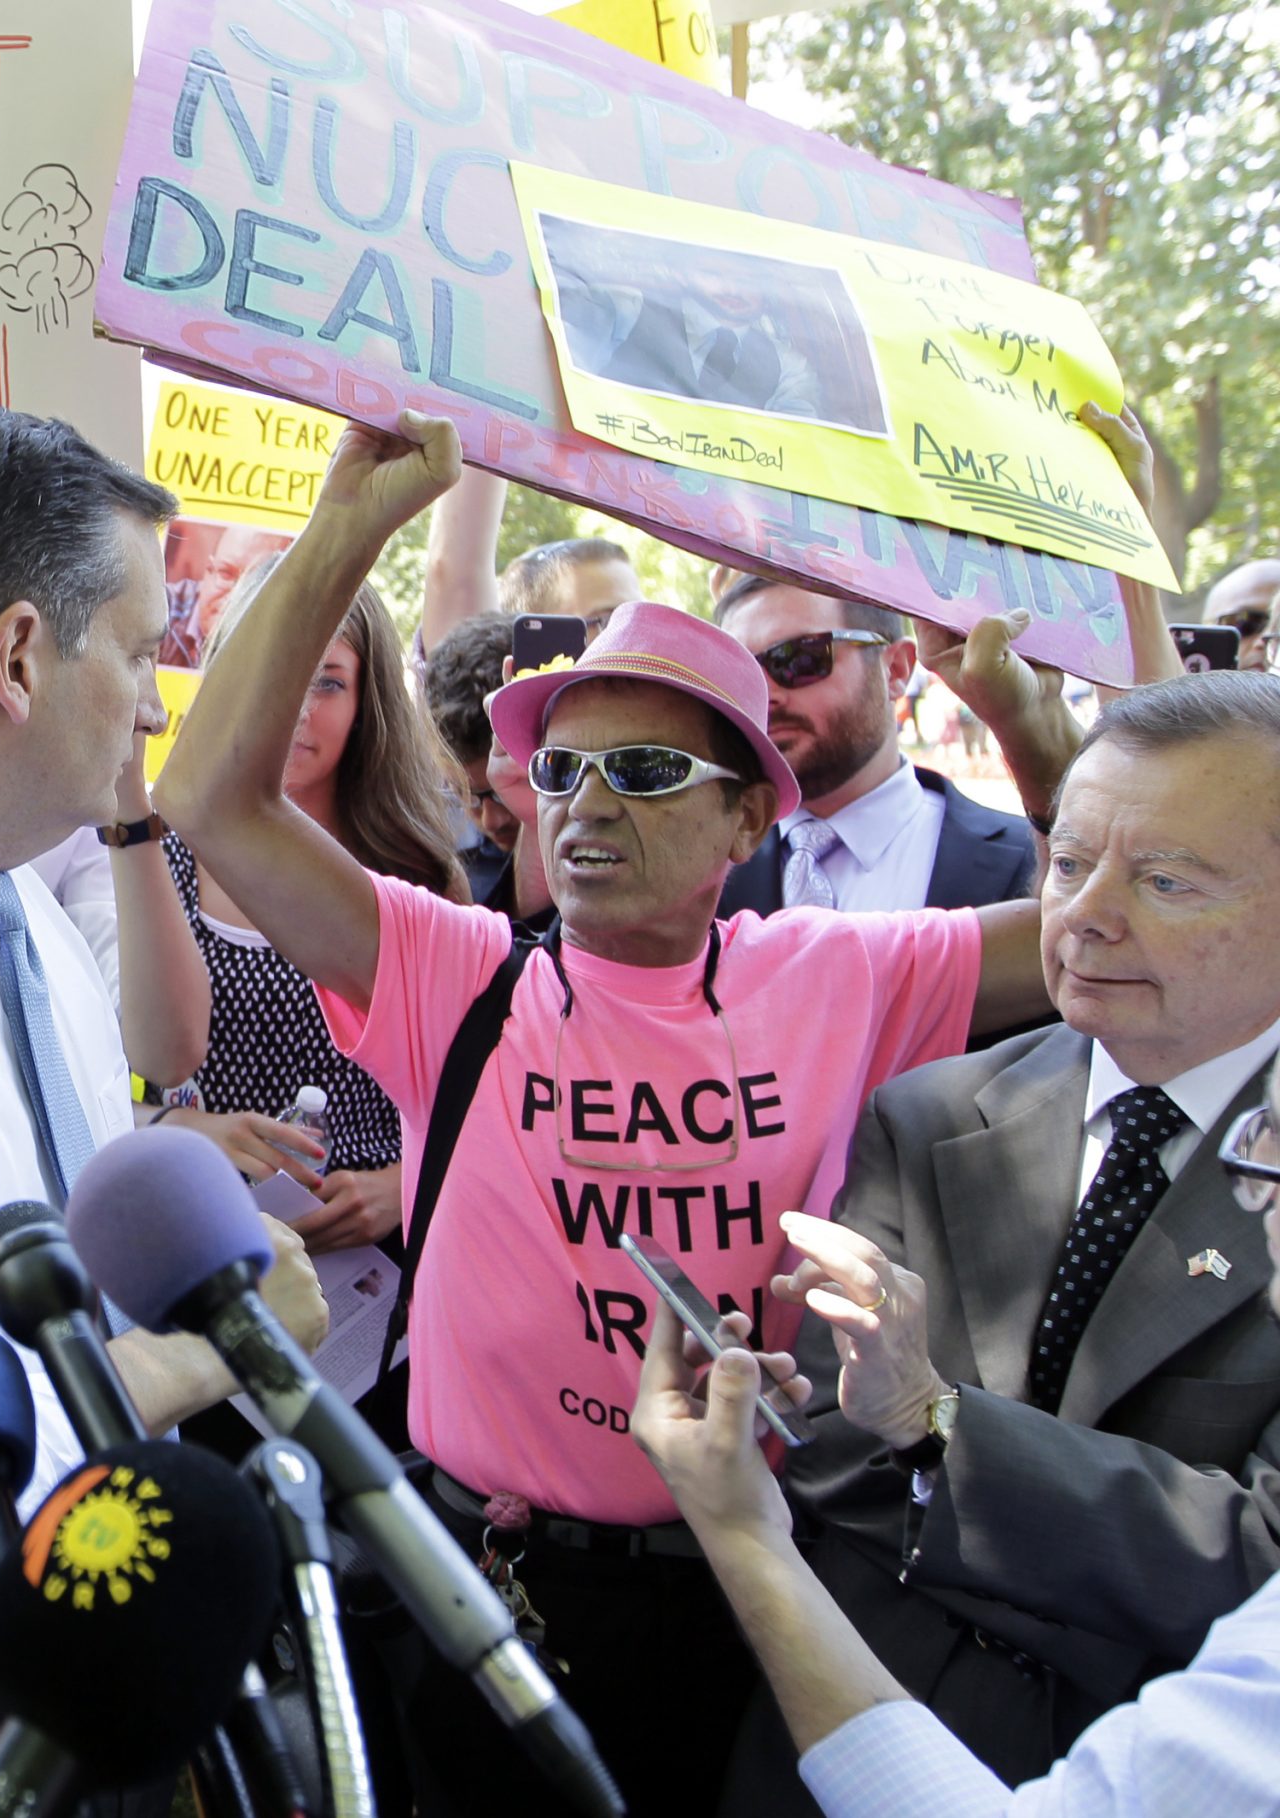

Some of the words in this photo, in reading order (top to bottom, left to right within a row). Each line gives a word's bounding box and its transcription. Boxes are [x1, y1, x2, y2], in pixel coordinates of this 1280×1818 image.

[123, 176, 543, 421] DEAL
[165, 390, 234, 437] ONE
[254, 407, 333, 457] YEAR
[521, 1071, 787, 1145] PEACE
[551, 1178, 764, 1252] WITH
[576, 1281, 764, 1360] IRN
